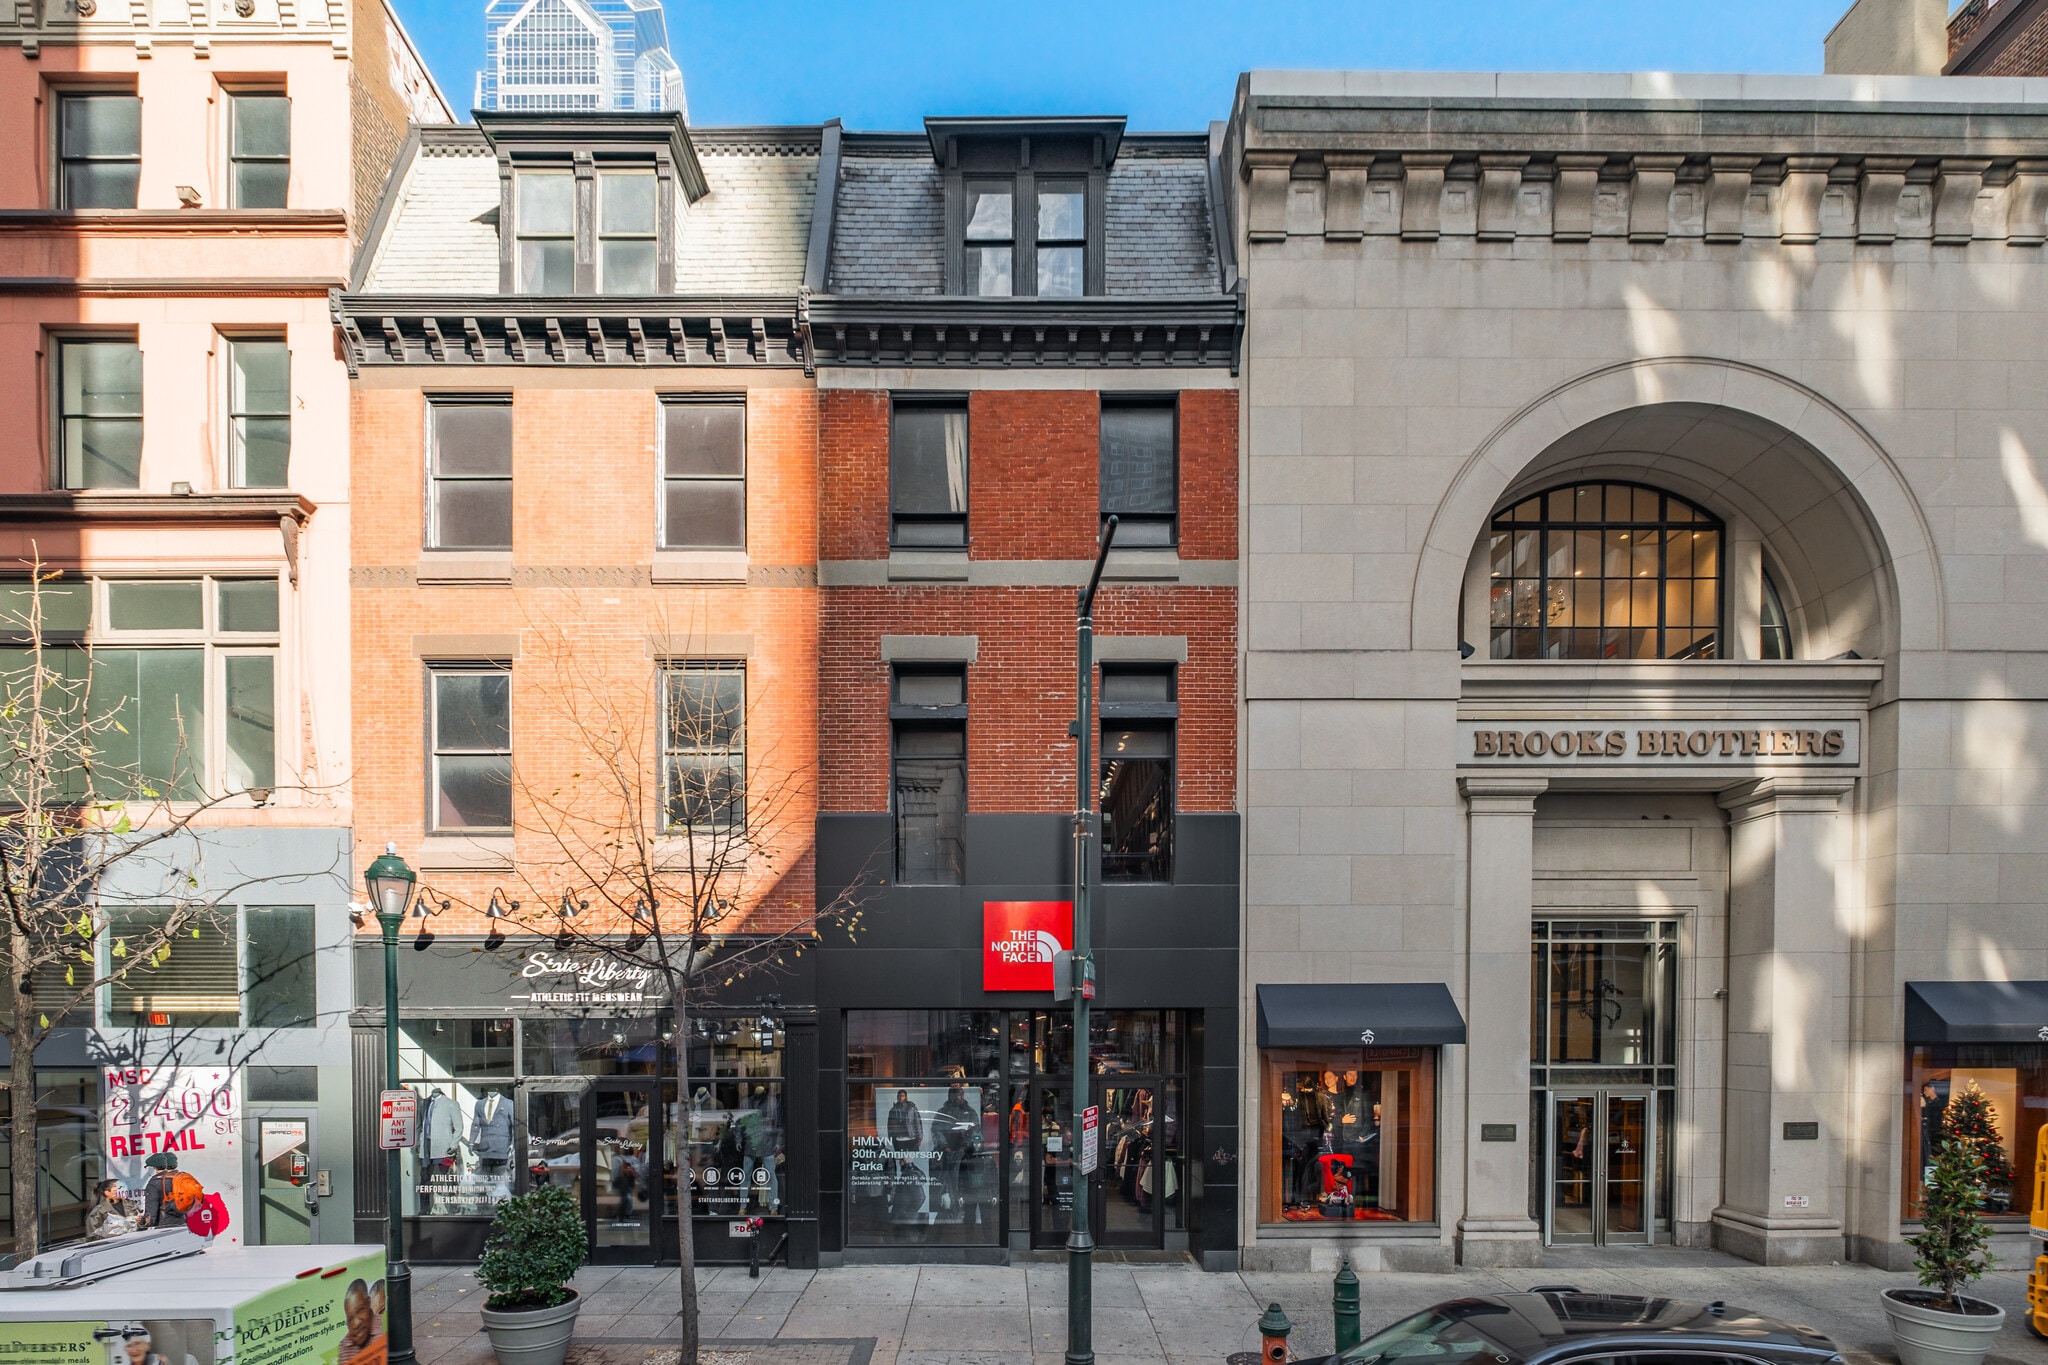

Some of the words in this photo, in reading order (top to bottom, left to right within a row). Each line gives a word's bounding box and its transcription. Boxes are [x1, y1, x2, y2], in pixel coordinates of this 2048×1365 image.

[1473, 730, 1627, 757] BROOKS
[1637, 729, 1845, 757] BROTHERS
[1010, 930, 1036, 941] THE
[991, 941, 1036, 952] NORTH
[1002, 951, 1036, 963] FACE
[522, 951, 580, 978] State
[579, 957, 652, 989] Liberty
[530, 992, 574, 1002] ATHLETIC
[593, 992, 643, 1002] MENSWEAR
[109, 1069, 151, 1088] MSC
[111, 1083, 237, 1129] 2,400
[383, 1105, 392, 1115] NO
[393, 1105, 414, 1113] PARKING
[391, 1119, 406, 1127] ANY
[390, 1128, 407, 1136] TIME
[110, 1128, 205, 1158] RETAIL
[852, 1136, 893, 1147] HMLYN
[852, 1148, 876, 1159] 30th
[879, 1148, 944, 1161] Anniversary
[852, 1161, 884, 1171] Parka
[240, 1325, 271, 1346] PCA
